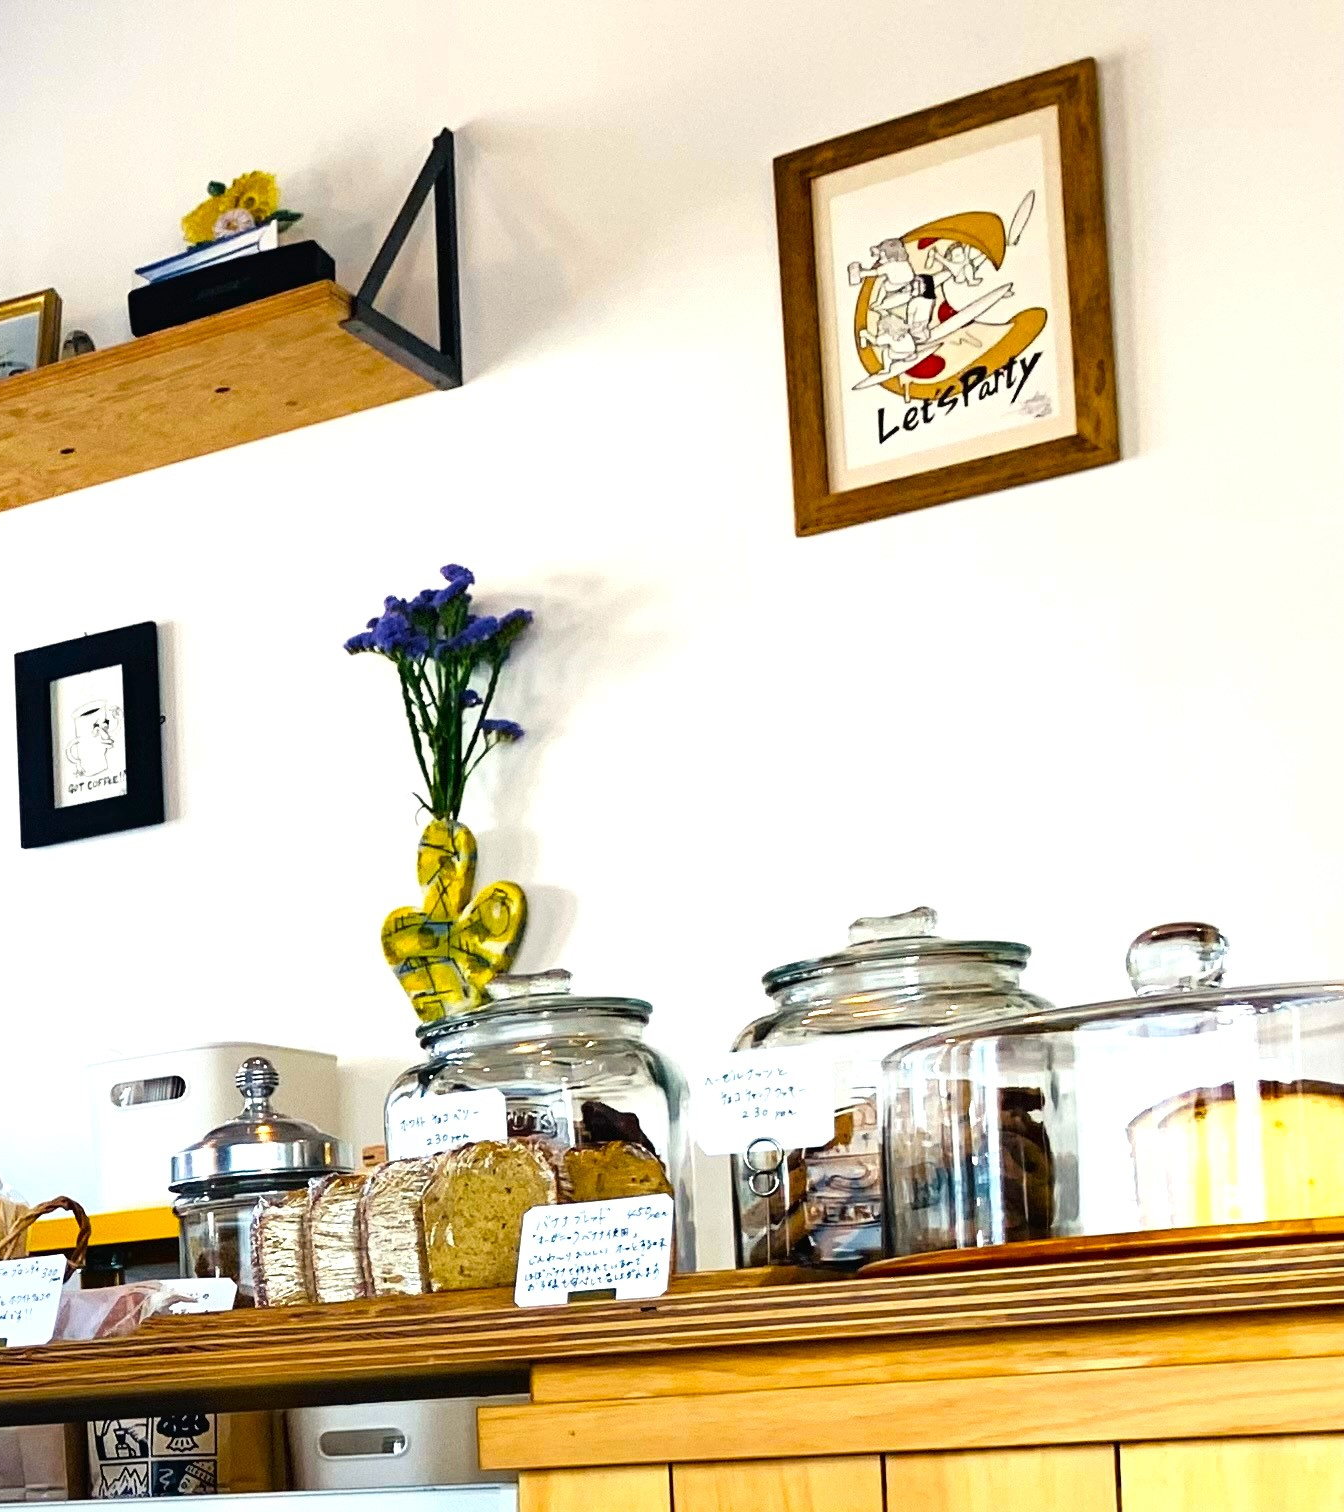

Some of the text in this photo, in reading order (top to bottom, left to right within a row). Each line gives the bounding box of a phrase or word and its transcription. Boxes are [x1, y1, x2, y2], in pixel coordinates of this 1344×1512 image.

[876, 351, 1044, 445] Let's Party
[741, 1106, 769, 1119] 230
